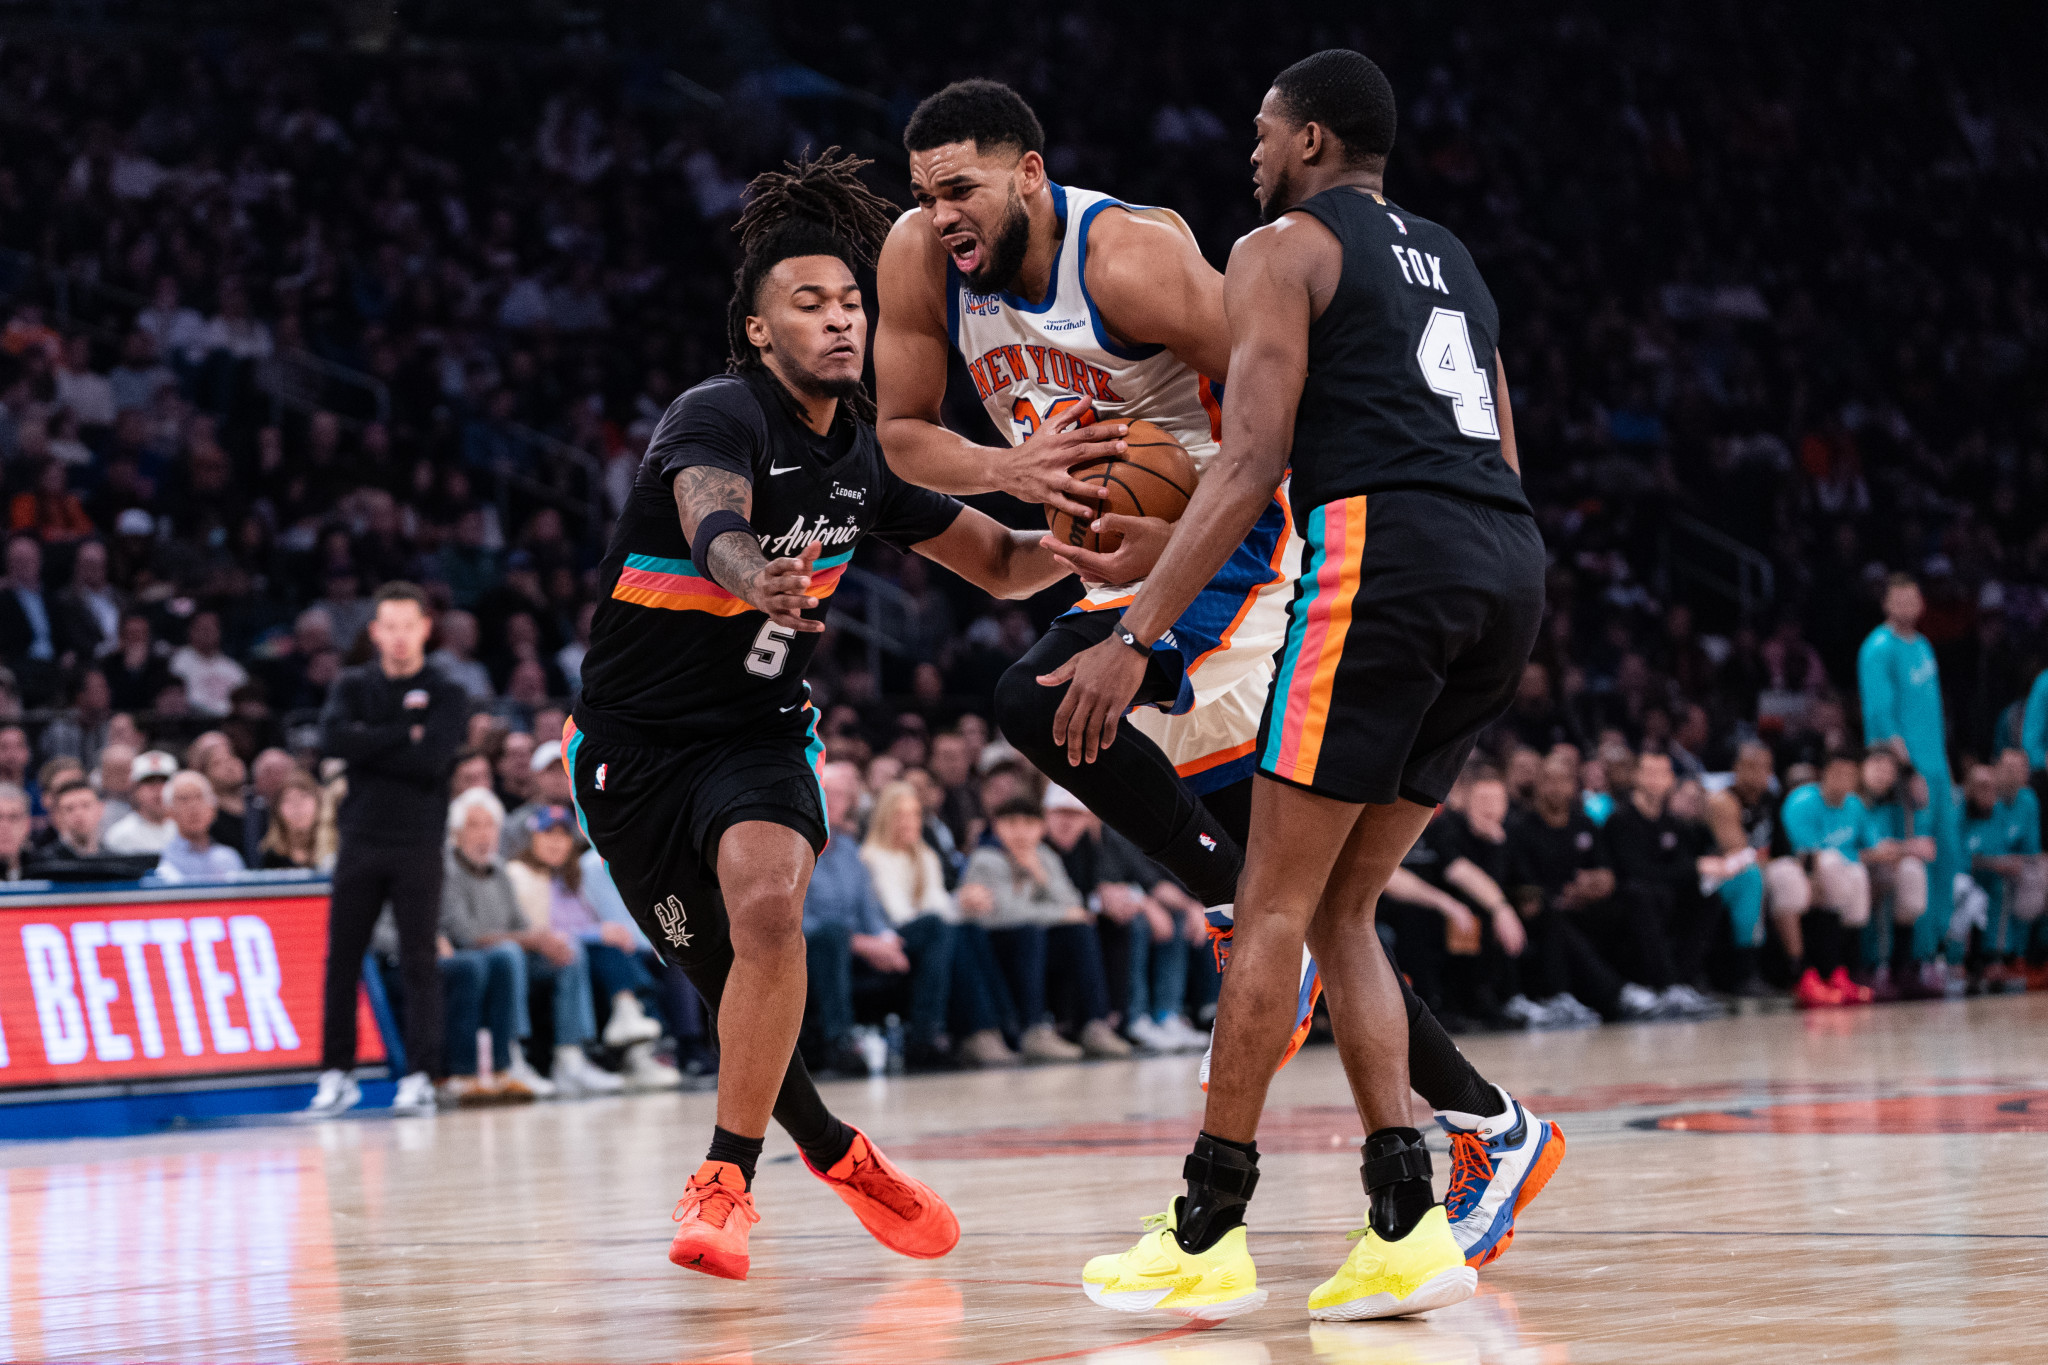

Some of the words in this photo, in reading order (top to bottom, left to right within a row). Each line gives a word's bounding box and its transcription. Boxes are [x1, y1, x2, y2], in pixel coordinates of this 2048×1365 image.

[1391, 245, 1450, 295] FOX
[964, 292, 1000, 316] NYC
[969, 343, 1030, 401] NEW
[1025, 346, 1126, 402] YORK
[1416, 306, 1501, 441] 4
[835, 486, 862, 500] LEDGER
[771, 514, 860, 556] Antonio
[744, 618, 797, 680] 5
[20, 914, 301, 1066] BETTER
